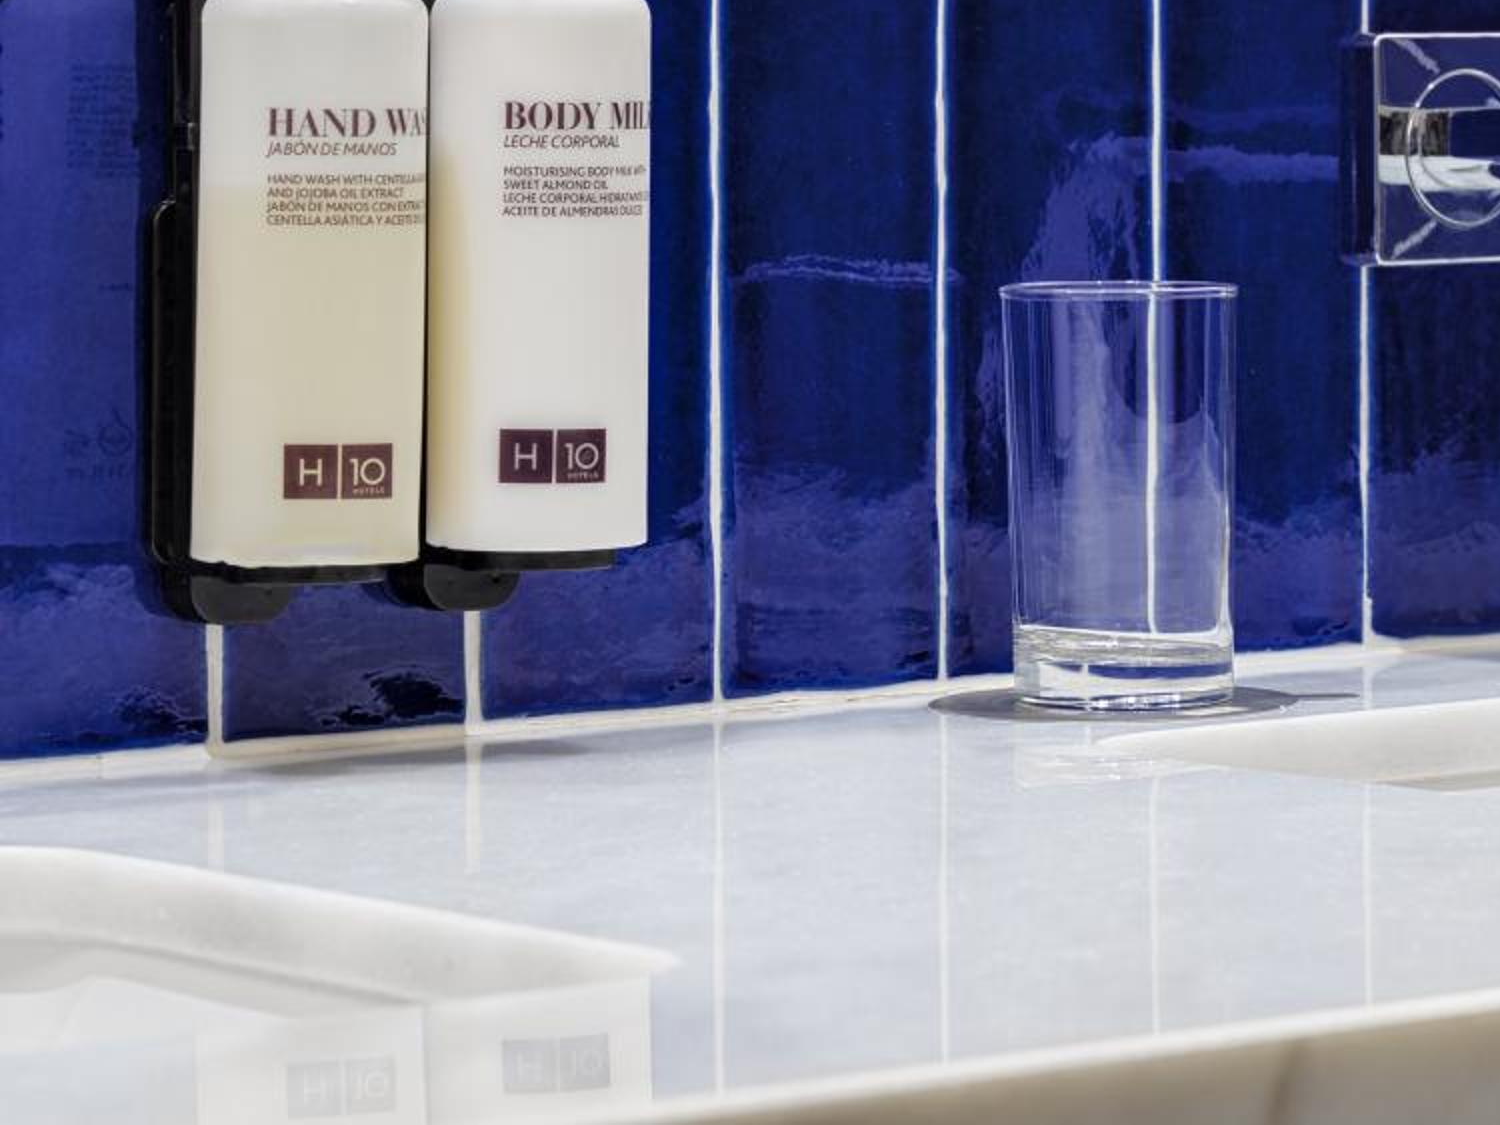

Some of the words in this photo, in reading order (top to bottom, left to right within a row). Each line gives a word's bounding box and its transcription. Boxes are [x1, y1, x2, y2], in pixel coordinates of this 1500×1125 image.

[267, 107, 376, 137] HAND
[503, 101, 602, 130] BODY
[609, 101, 650, 130] MIL
[503, 134, 549, 148] LECHE
[551, 134, 620, 149] CORPORAL
[320, 142, 341, 156] DE
[343, 142, 398, 156] MANOS
[267, 174, 303, 185] HAND
[305, 174, 340, 185] WASH
[343, 174, 372, 185] WITH
[503, 180, 539, 190] SWEET
[542, 180, 590, 190] ALMOND
[267, 187, 293, 198] AND
[503, 193, 537, 204] LECHE
[539, 193, 598, 204] CORPORAL
[308, 202, 323, 212] DE
[326, 202, 369, 213] MANOS
[514, 442, 537, 470] H
[564, 442, 599, 470] 10
[299, 458, 322, 487] H
[349, 457, 385, 486] 10
